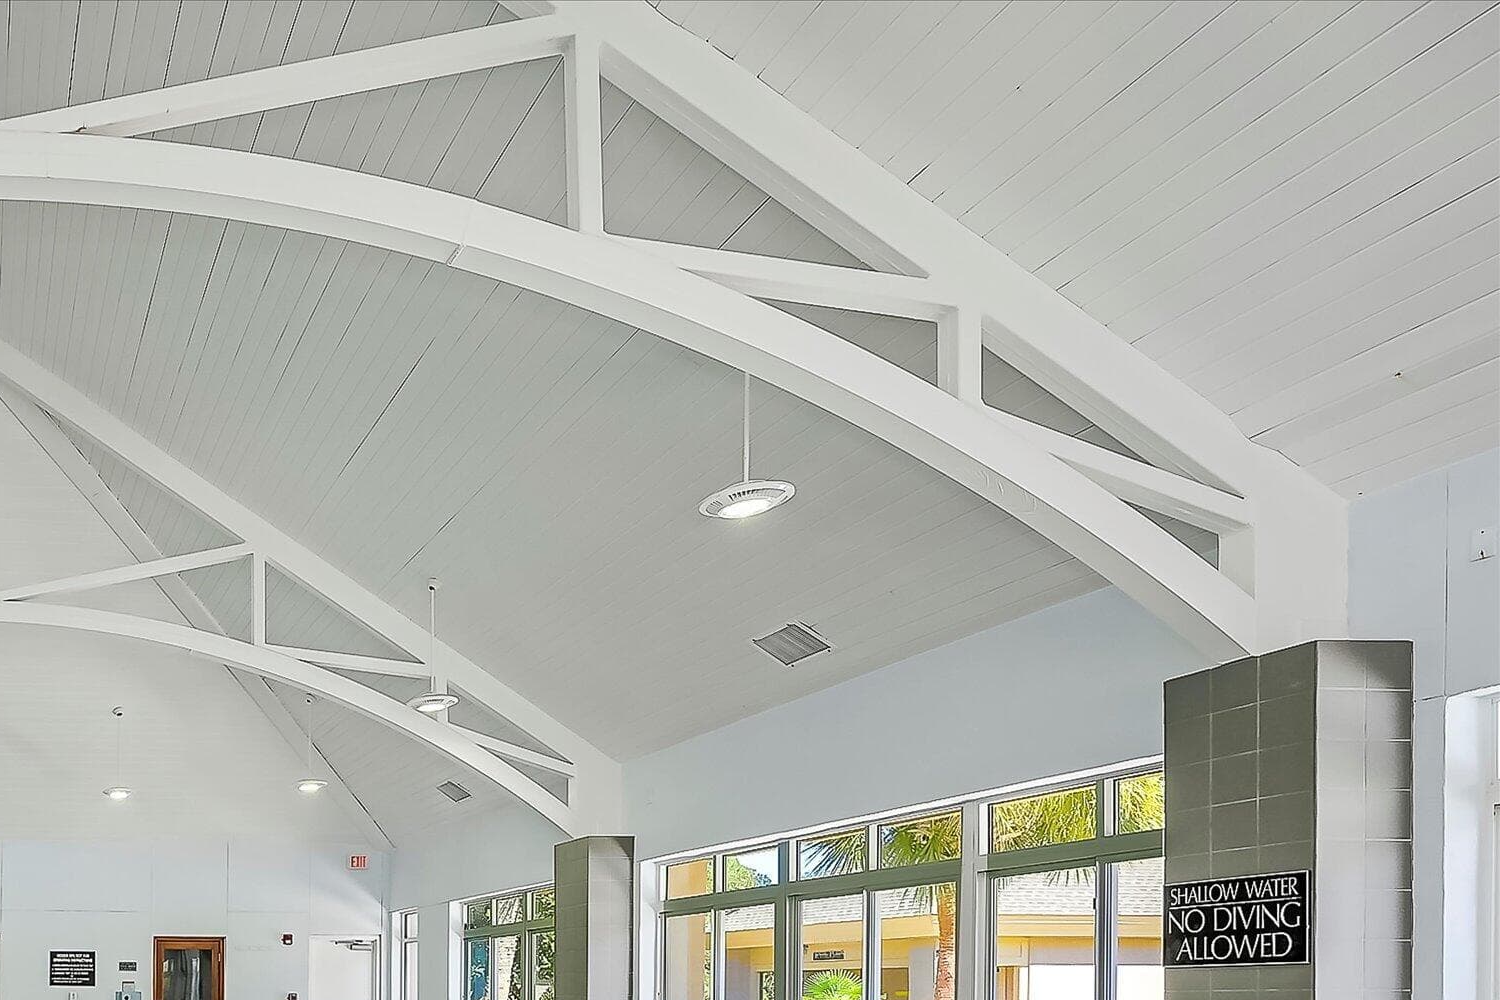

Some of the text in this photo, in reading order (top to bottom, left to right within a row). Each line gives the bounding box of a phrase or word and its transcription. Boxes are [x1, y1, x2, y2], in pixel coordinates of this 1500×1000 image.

[351, 856, 367, 867] EXIT
[1170, 876, 1299, 906] SHALLOW WATER
[1168, 901, 1301, 934] NO DIVING
[1175, 931, 1293, 962] ALLOWED
